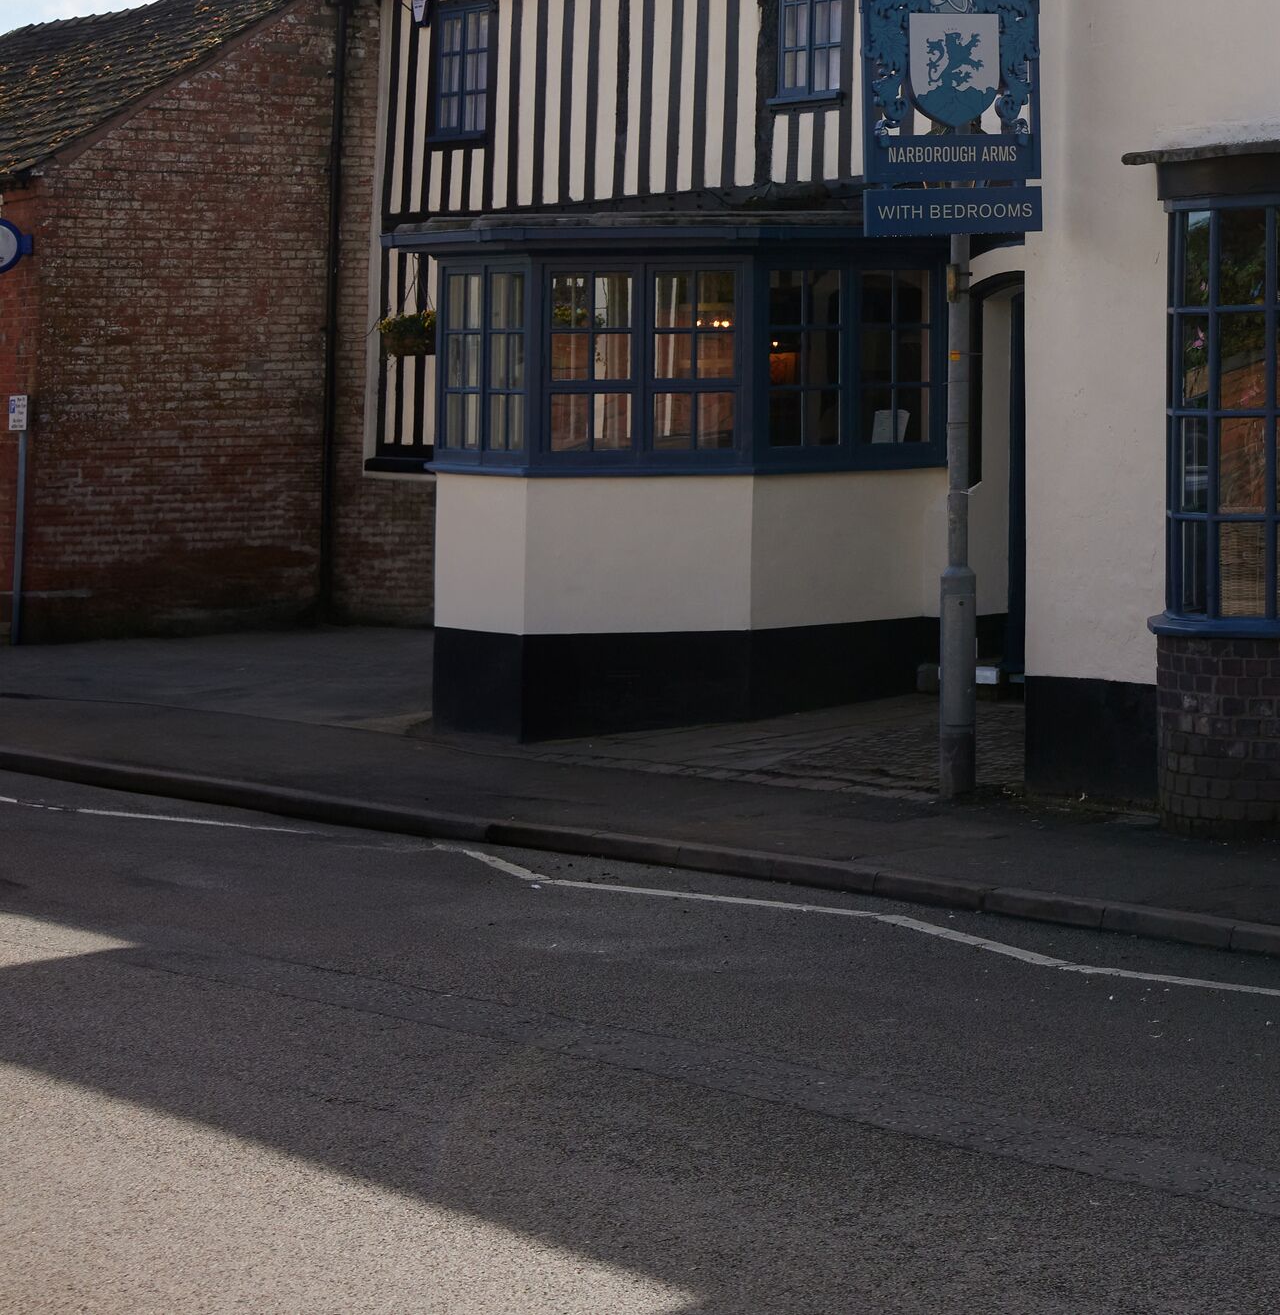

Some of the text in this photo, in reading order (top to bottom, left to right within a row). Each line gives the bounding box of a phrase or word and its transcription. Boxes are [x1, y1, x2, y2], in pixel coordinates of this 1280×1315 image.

[888, 145, 1017, 163] NARBOROUGH ARMS
[878, 203, 1033, 219] WITH BEDROOMS
